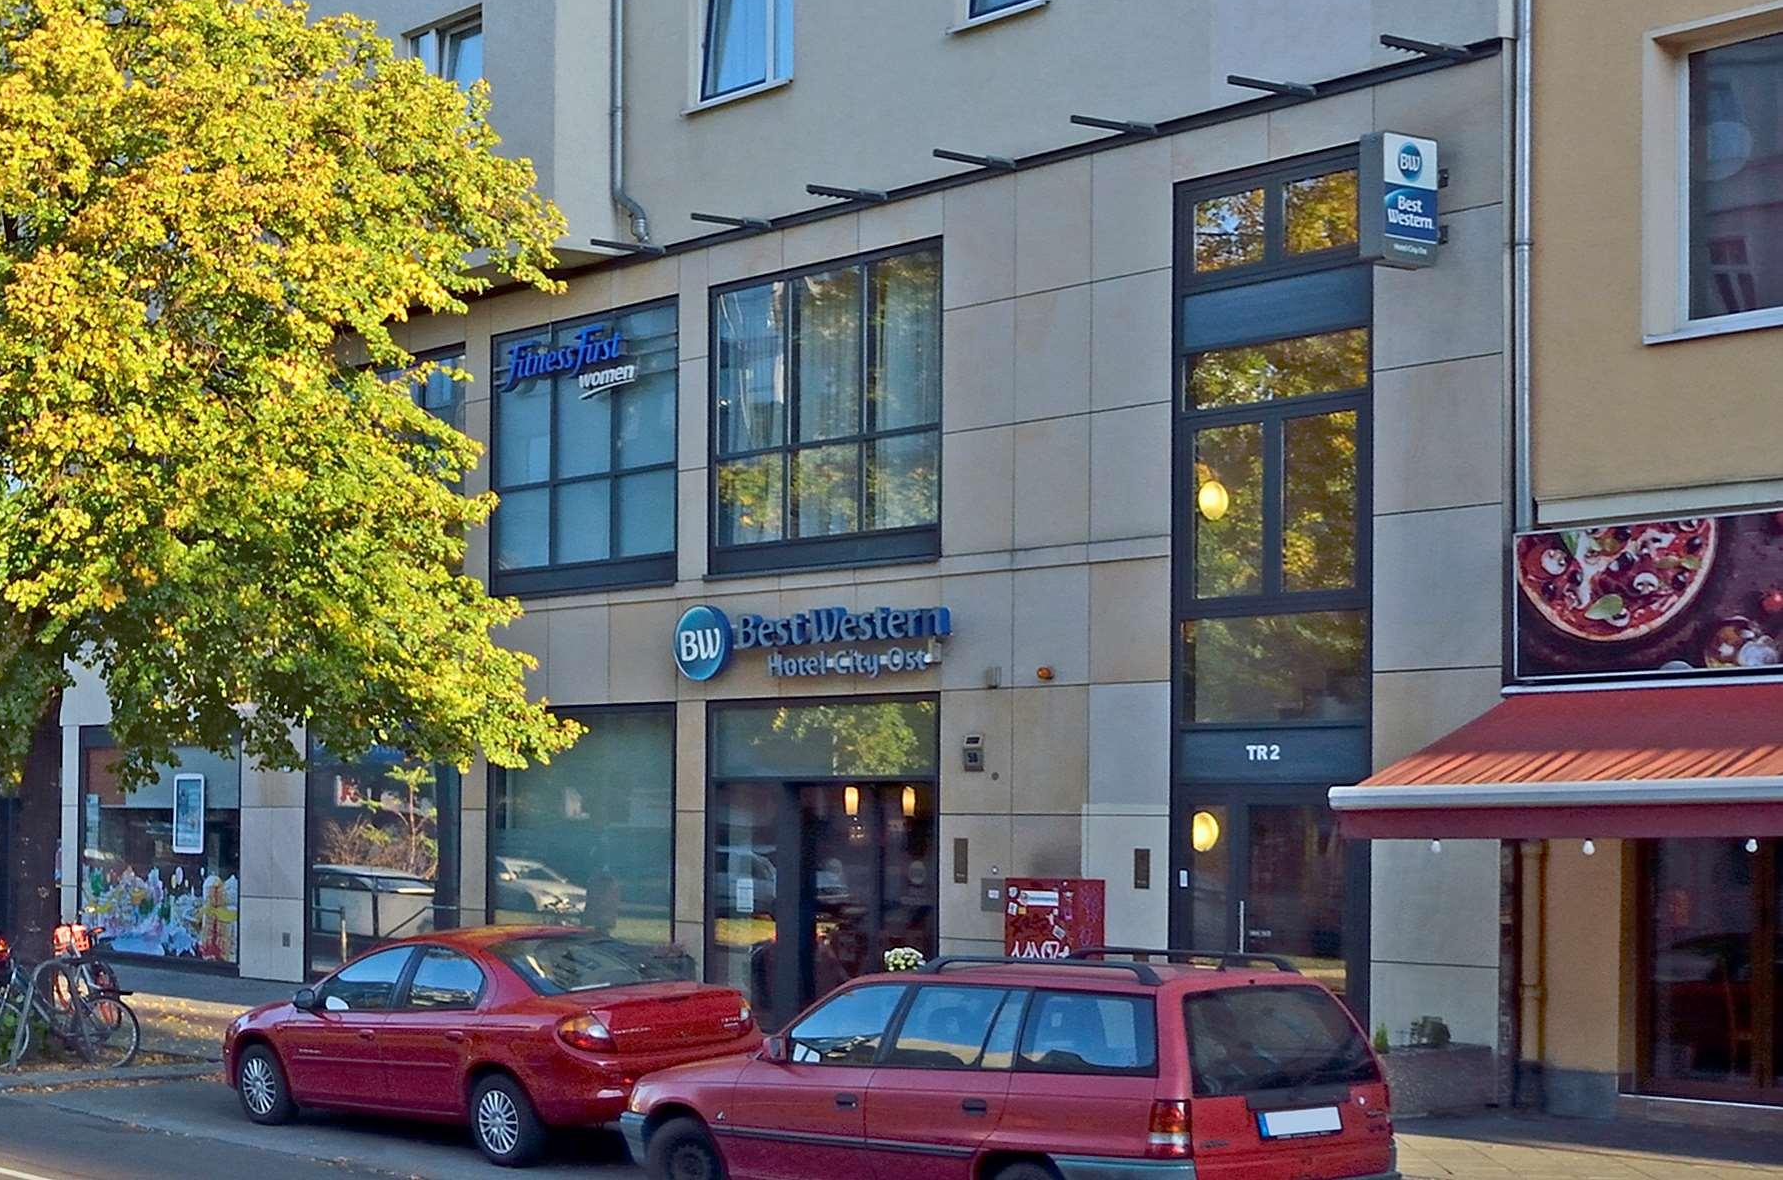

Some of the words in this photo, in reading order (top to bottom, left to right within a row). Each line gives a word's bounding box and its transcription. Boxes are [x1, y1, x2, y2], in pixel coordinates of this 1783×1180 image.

[1400, 153, 1420, 171] BW
[1398, 195, 1423, 213] Best
[1387, 208, 1434, 229] Western
[578, 365, 635, 388] women
[734, 612, 808, 649] Best
[808, 606, 951, 644] Western
[679, 628, 720, 662] BW
[768, 650, 827, 677] Hotel
[833, 649, 880, 678] City
[887, 646, 927, 672] Ost
